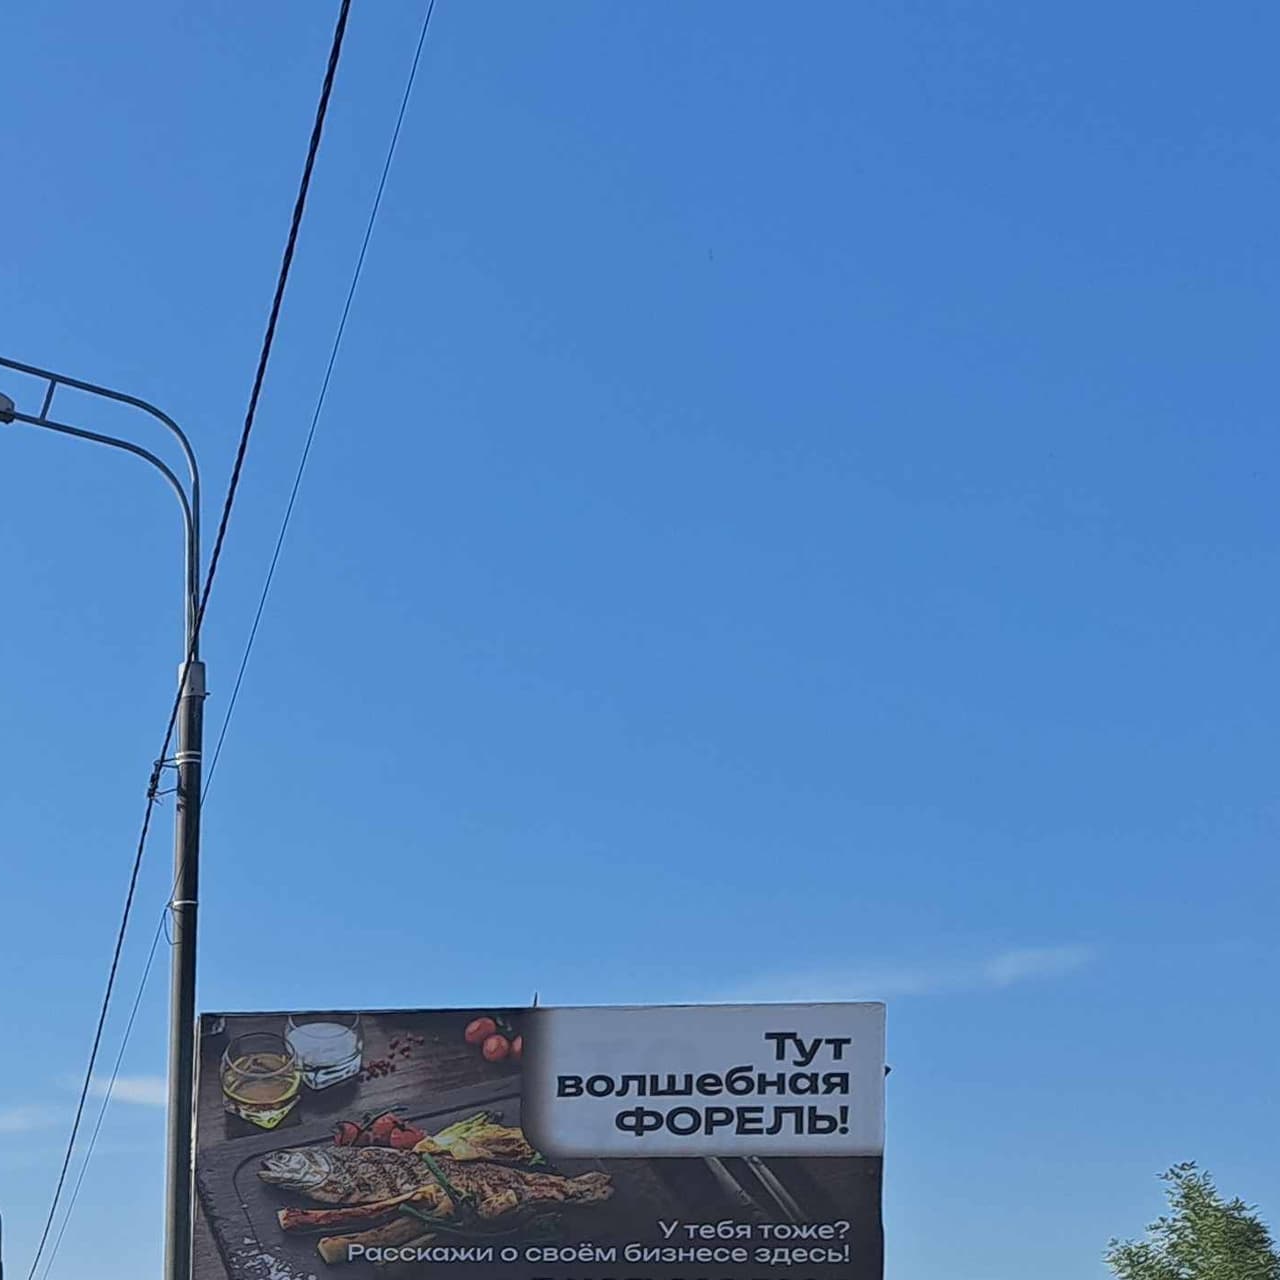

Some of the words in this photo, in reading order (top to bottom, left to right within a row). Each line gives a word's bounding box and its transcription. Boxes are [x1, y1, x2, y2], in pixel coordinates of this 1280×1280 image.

[764, 1032, 851, 1066] Тут
[556, 1065, 850, 1097] волшебная
[615, 1105, 850, 1136] ФОРЕЛЬ!
[658, 1220, 679, 1239] У
[683, 1220, 751, 1239] тебя
[758, 1220, 850, 1239] тоже?
[347, 1243, 494, 1262] Расскажи
[500, 1247, 518, 1262] о
[524, 1243, 617, 1262] своём
[624, 1243, 748, 1263] бизнесе
[754, 1244, 850, 1265] здесь!
